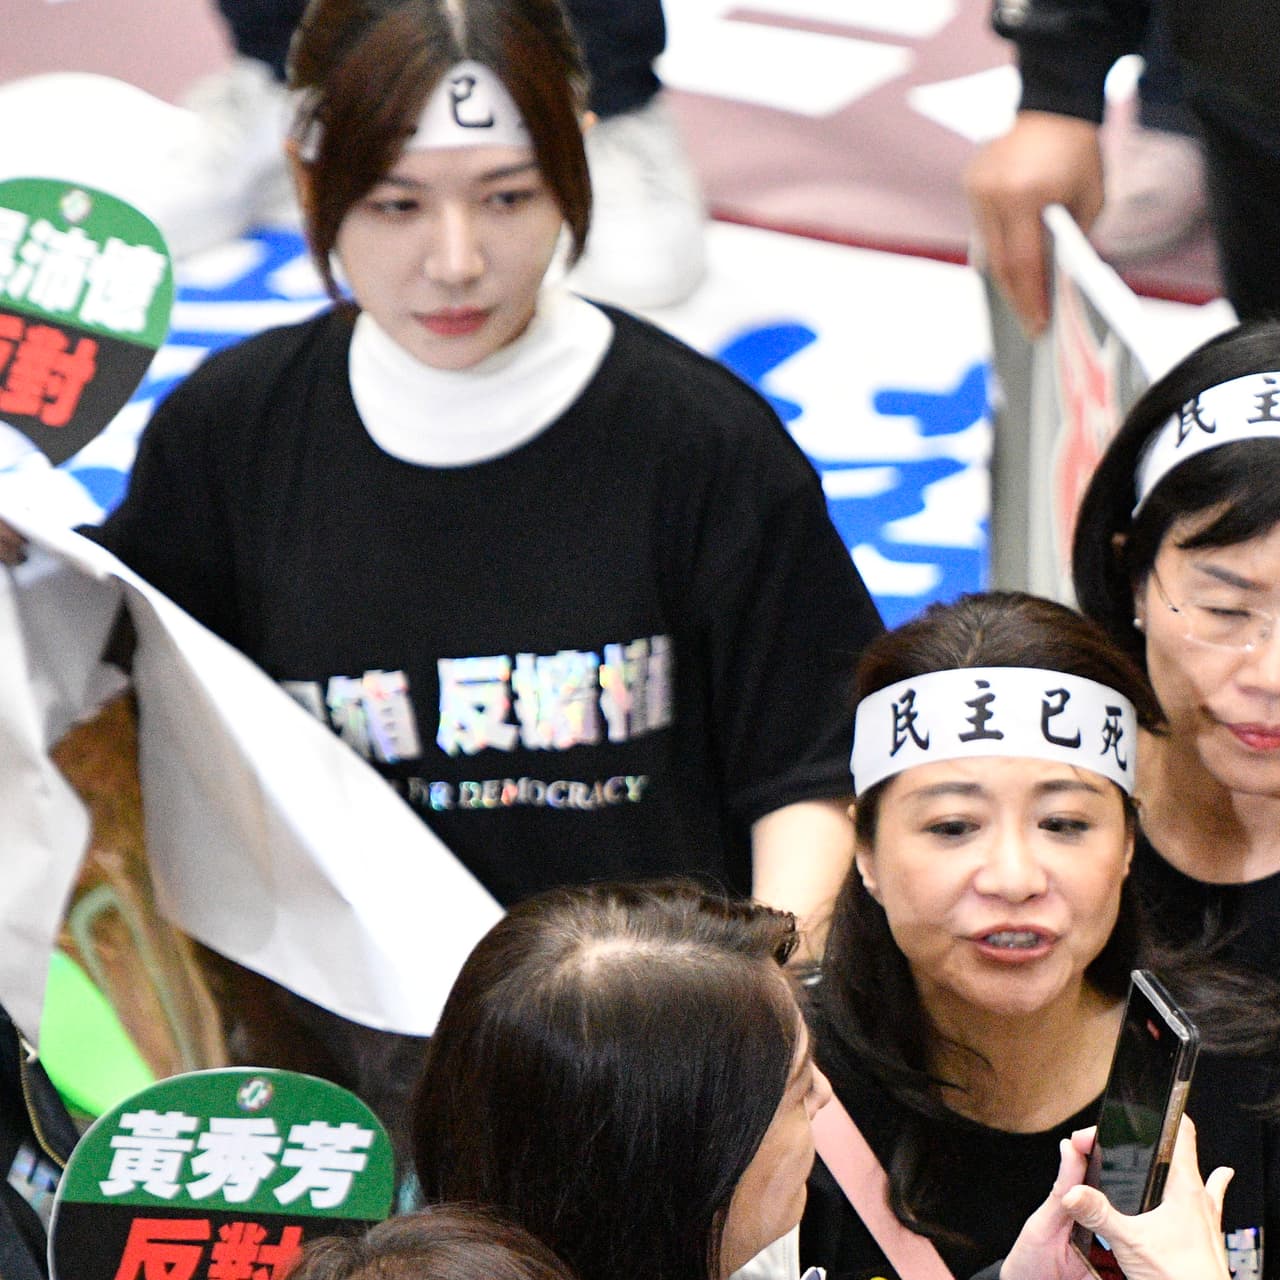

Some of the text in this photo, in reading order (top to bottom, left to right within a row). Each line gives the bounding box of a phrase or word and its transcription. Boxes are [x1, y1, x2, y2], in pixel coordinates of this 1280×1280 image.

[889, 680, 1127, 772] 民主已死
[99, 1110, 375, 1209] 黃秀芳
